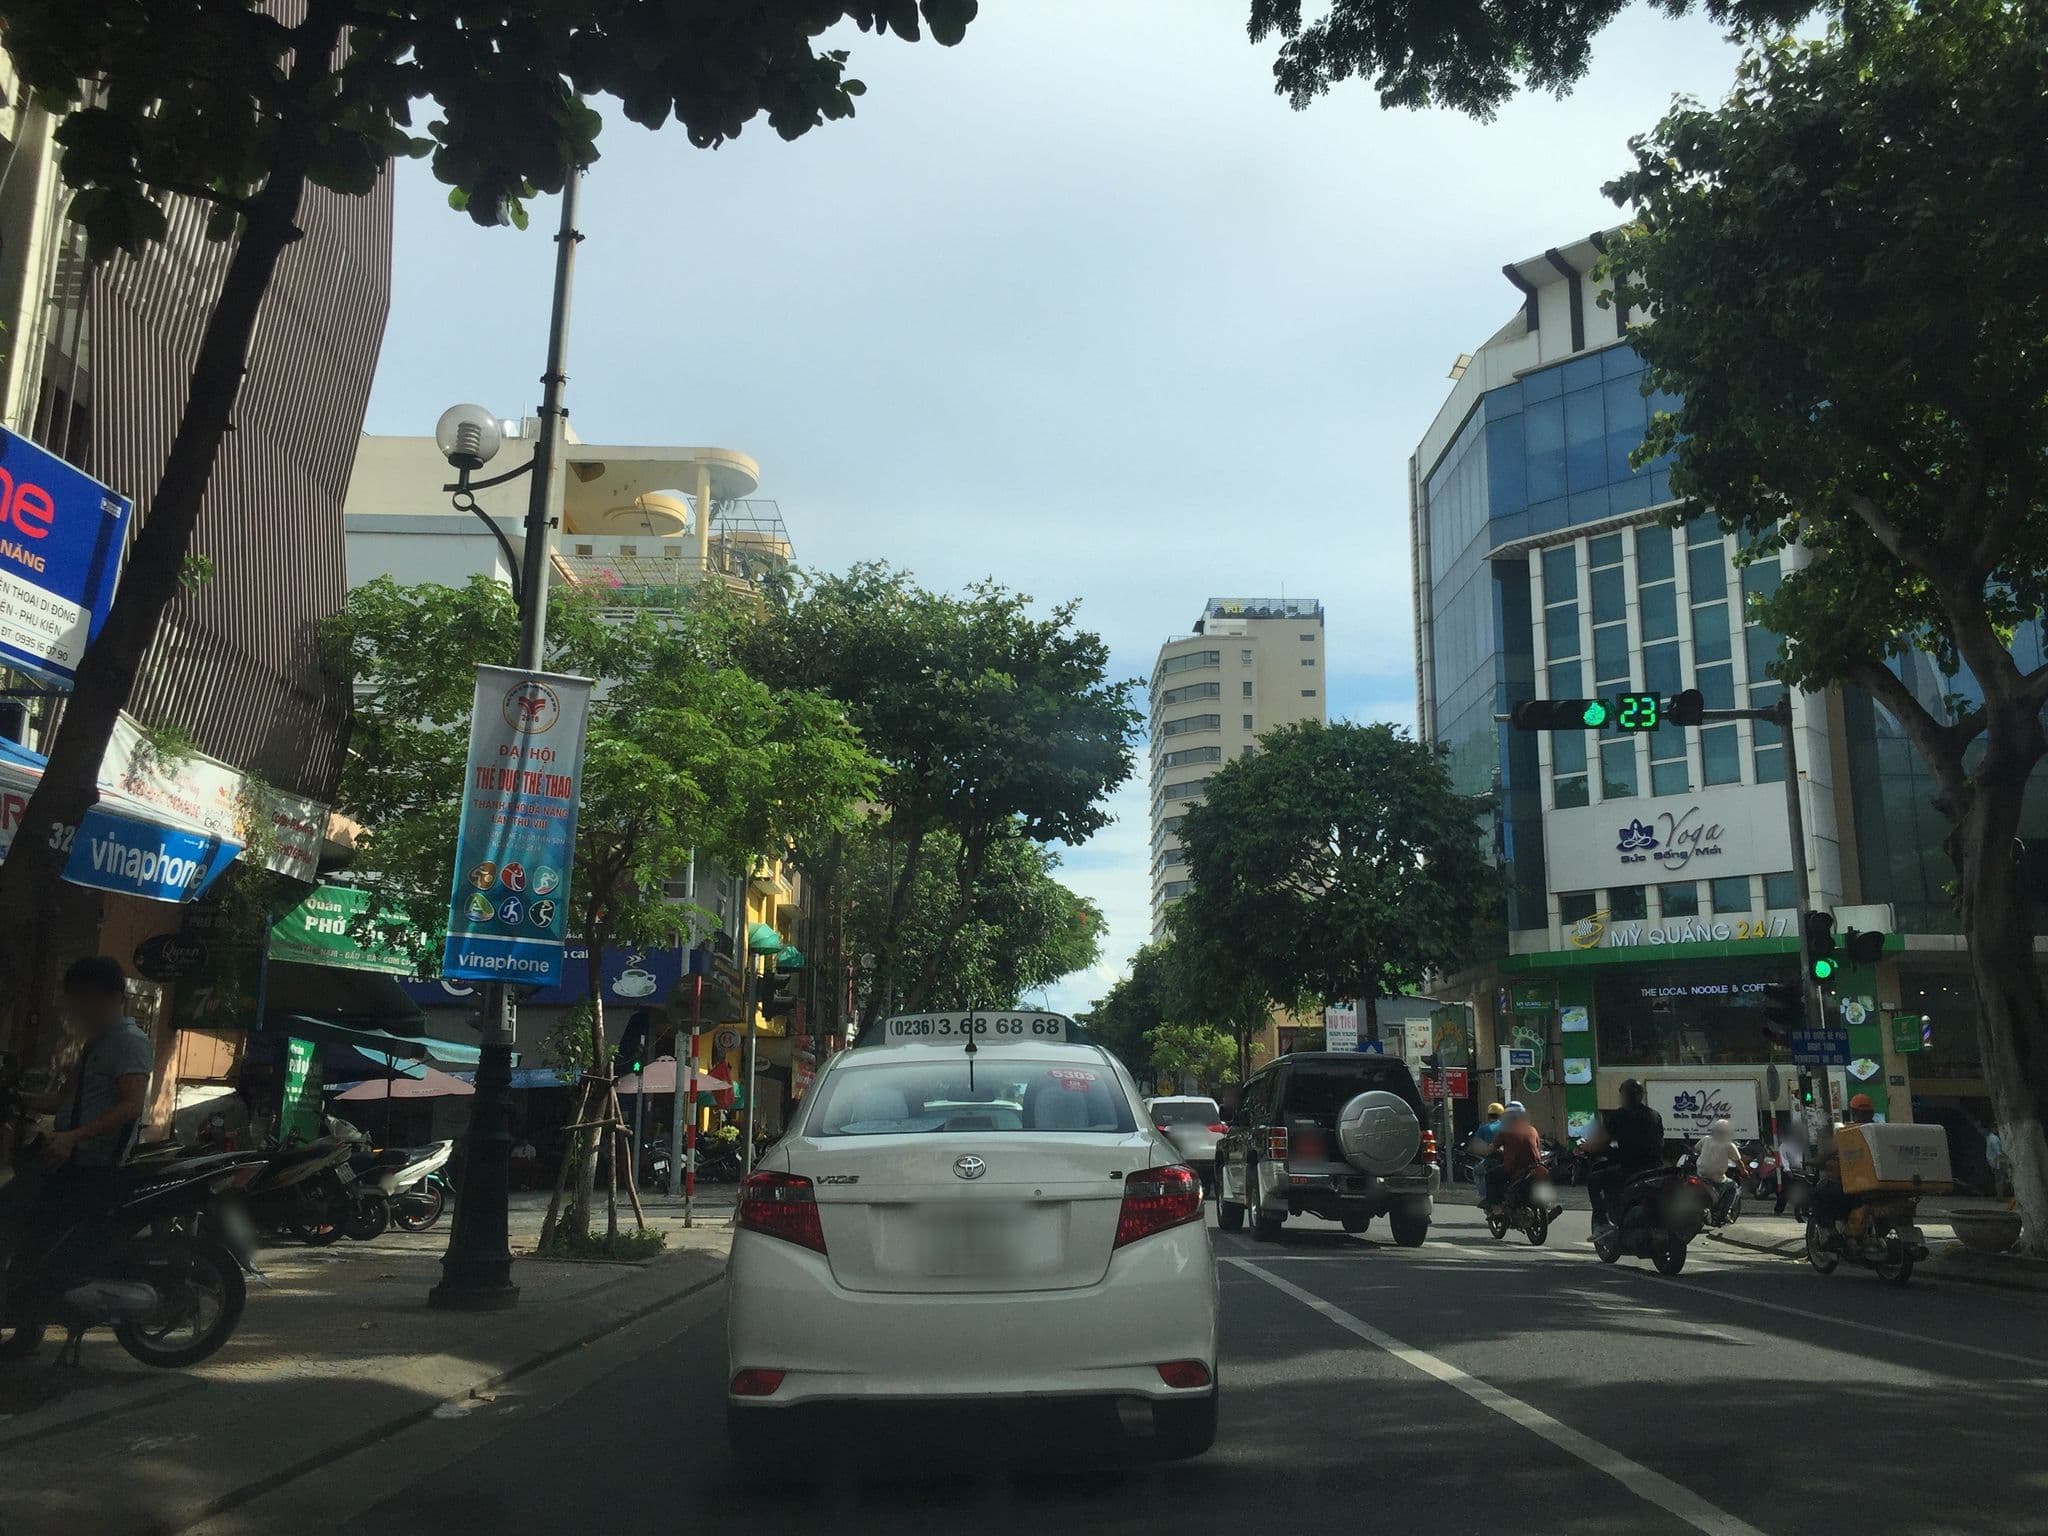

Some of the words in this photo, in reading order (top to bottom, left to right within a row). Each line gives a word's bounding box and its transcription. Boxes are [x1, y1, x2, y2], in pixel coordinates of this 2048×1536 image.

[40, 599, 50, 612] DI
[1620, 697, 1656, 727] 23
[545, 773, 573, 800] THAO
[1657, 806, 1724, 870] Yoga
[92, 832, 208, 889] vinaphone
[1649, 917, 1731, 945] QUẢNG
[1737, 917, 1788, 940] 24/7
[459, 951, 550, 973] vinaphone
[1640, 988, 1657, 997] THE
[1658, 986, 1688, 997] LOCAL
[1691, 984, 1729, 995] NOODLE
[1732, 984, 1739, 993] &
[996, 1018, 1024, 1034] 68
[1032, 1018, 1060, 1034] 68
[1695, 1089, 1733, 1128] Yoga
